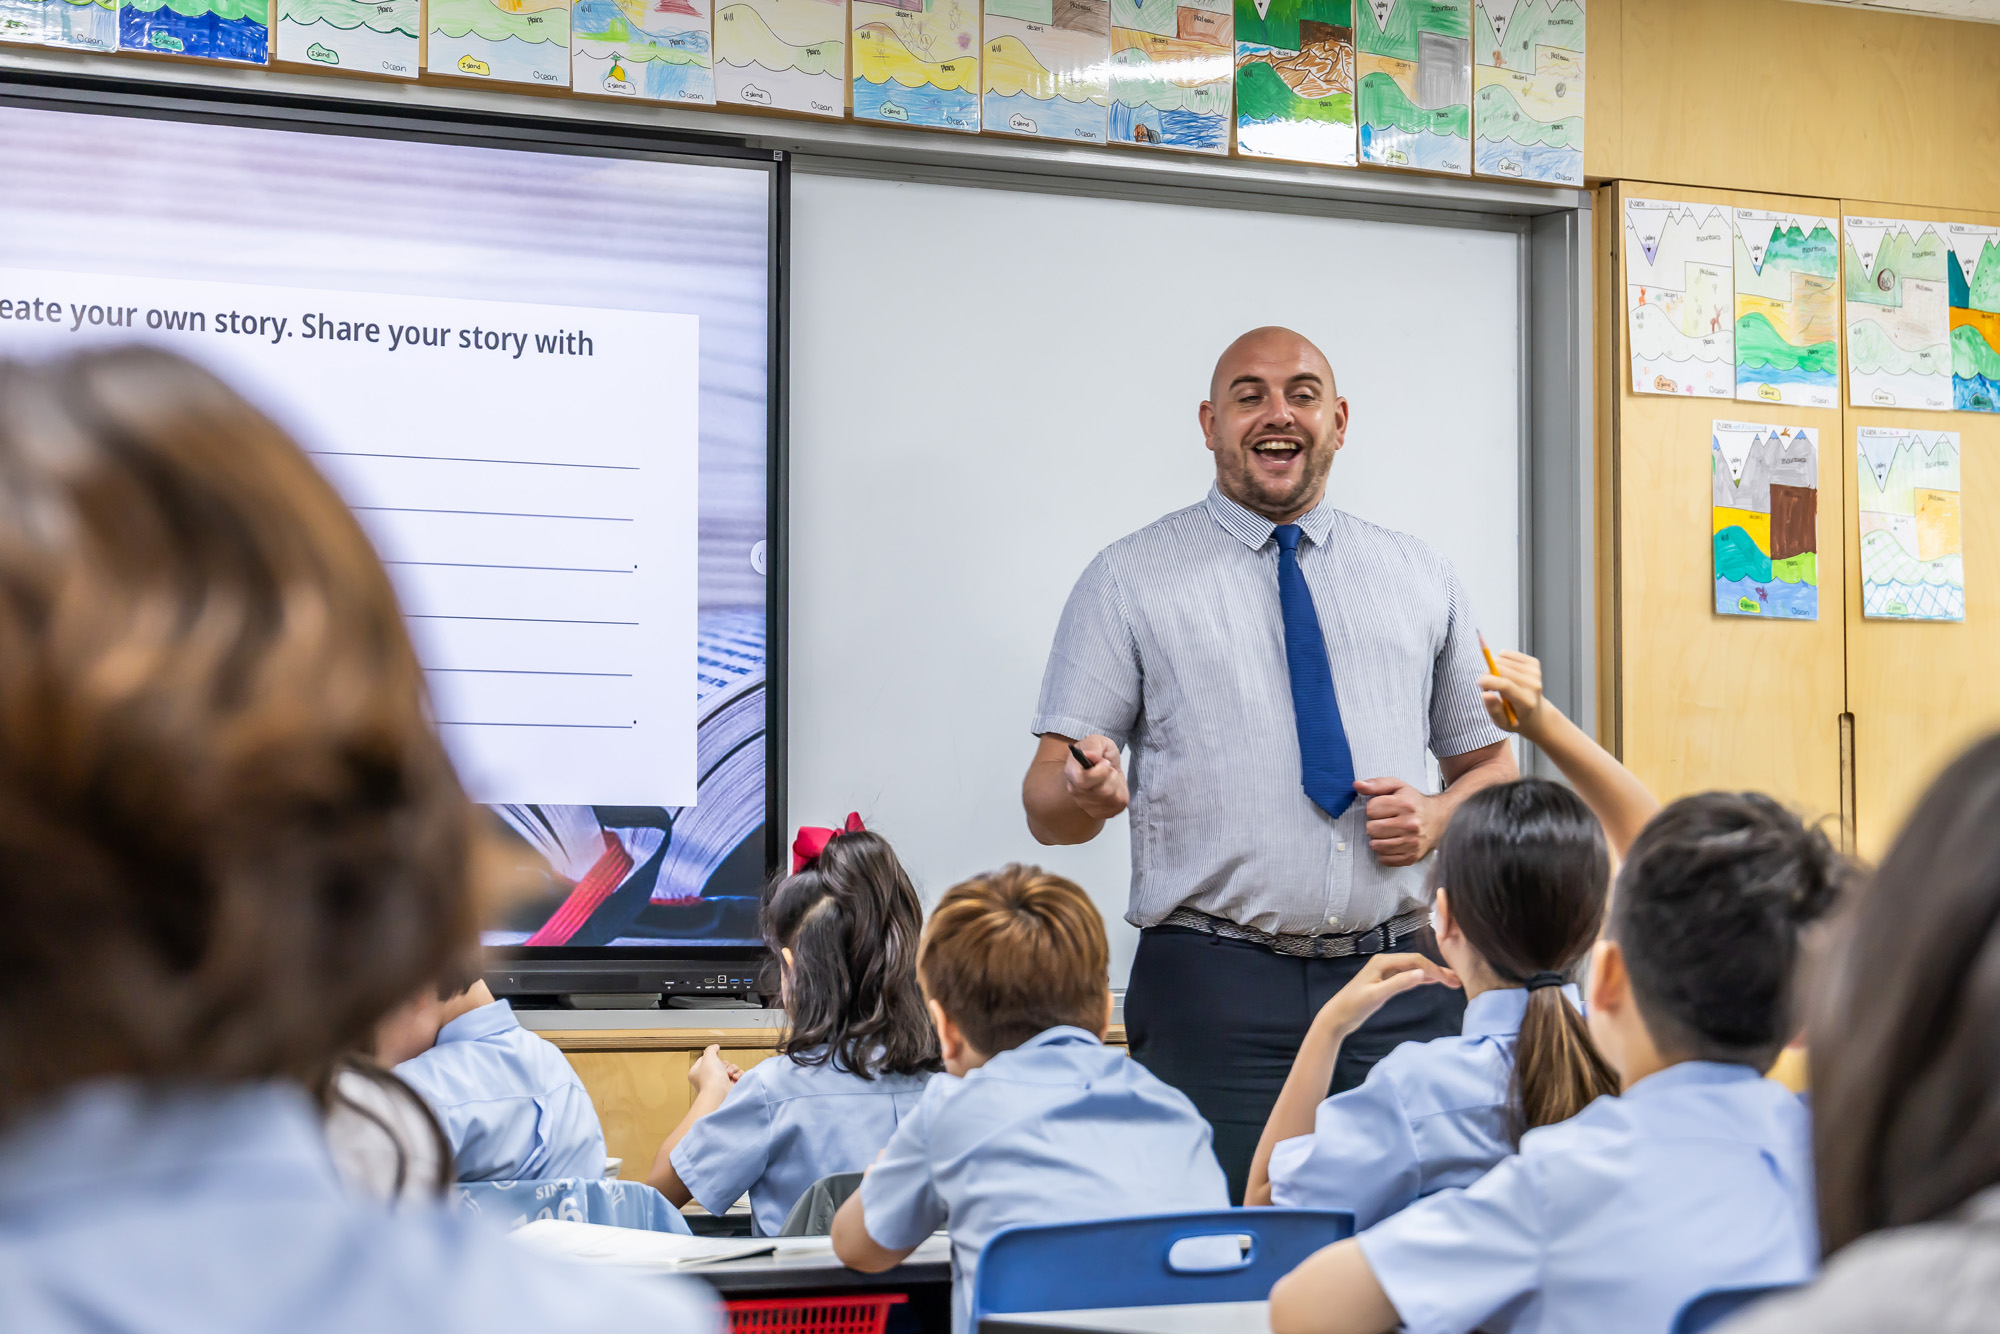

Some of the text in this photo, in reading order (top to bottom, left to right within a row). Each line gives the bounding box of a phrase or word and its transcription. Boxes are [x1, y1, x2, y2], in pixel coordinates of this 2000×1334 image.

[1026, 24, 1044, 33] desert
[77, 33, 104, 45] Ocean
[311, 50, 331, 59] Island
[382, 60, 407, 73] Ocean
[462, 62, 481, 70] Island
[533, 70, 558, 82] Ocean
[679, 90, 704, 100] Ocean
[745, 91, 764, 99] Island
[811, 100, 834, 112] Ocean
[884, 107, 901, 115] Island
[1074, 128, 1097, 138] Ocean
[1442, 160, 1462, 170] Ocean
[1555, 172, 1575, 182] Ocean
[0, 297, 594, 359] eate your own story. Share your story with
